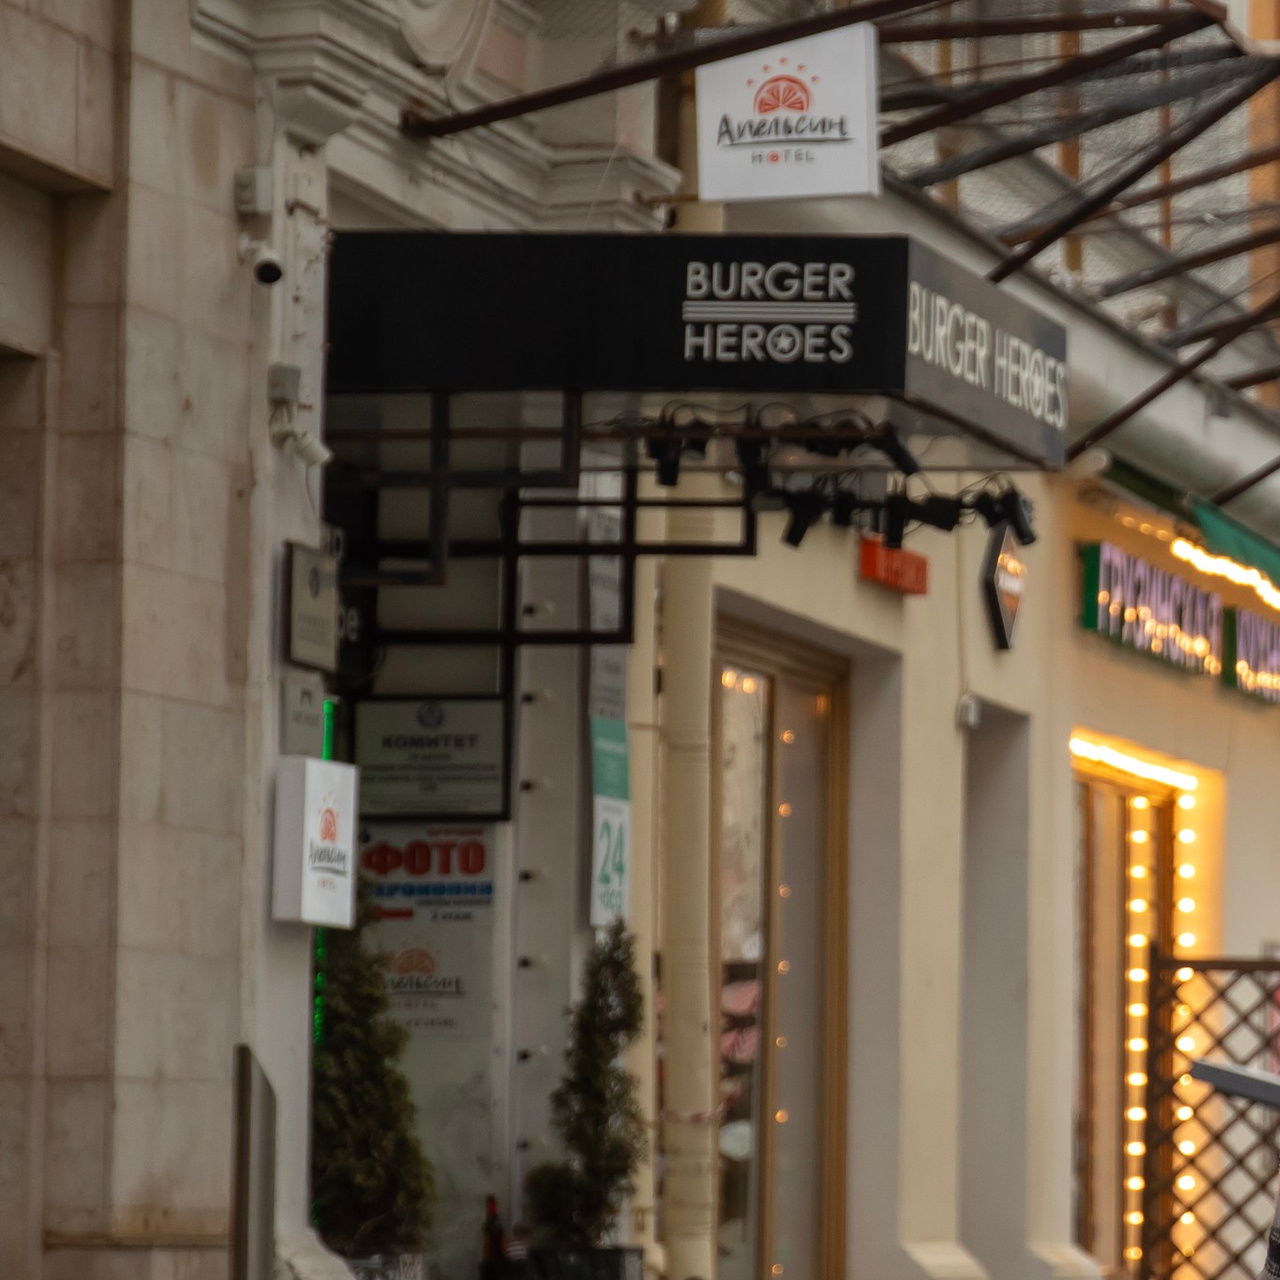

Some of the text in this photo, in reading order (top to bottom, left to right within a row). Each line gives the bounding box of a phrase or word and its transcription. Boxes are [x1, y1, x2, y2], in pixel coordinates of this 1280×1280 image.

[717, 113, 850, 146] Апельсин
[750, 148, 816, 166] HOTEL
[685, 261, 856, 301] BURGER
[683, 322, 854, 363] HEROES
[907, 280, 1067, 431] BURGER HEROES
[382, 732, 479, 750] КОМИТЕТ
[361, 841, 485, 876] ФОТО
[598, 818, 625, 884] 24
